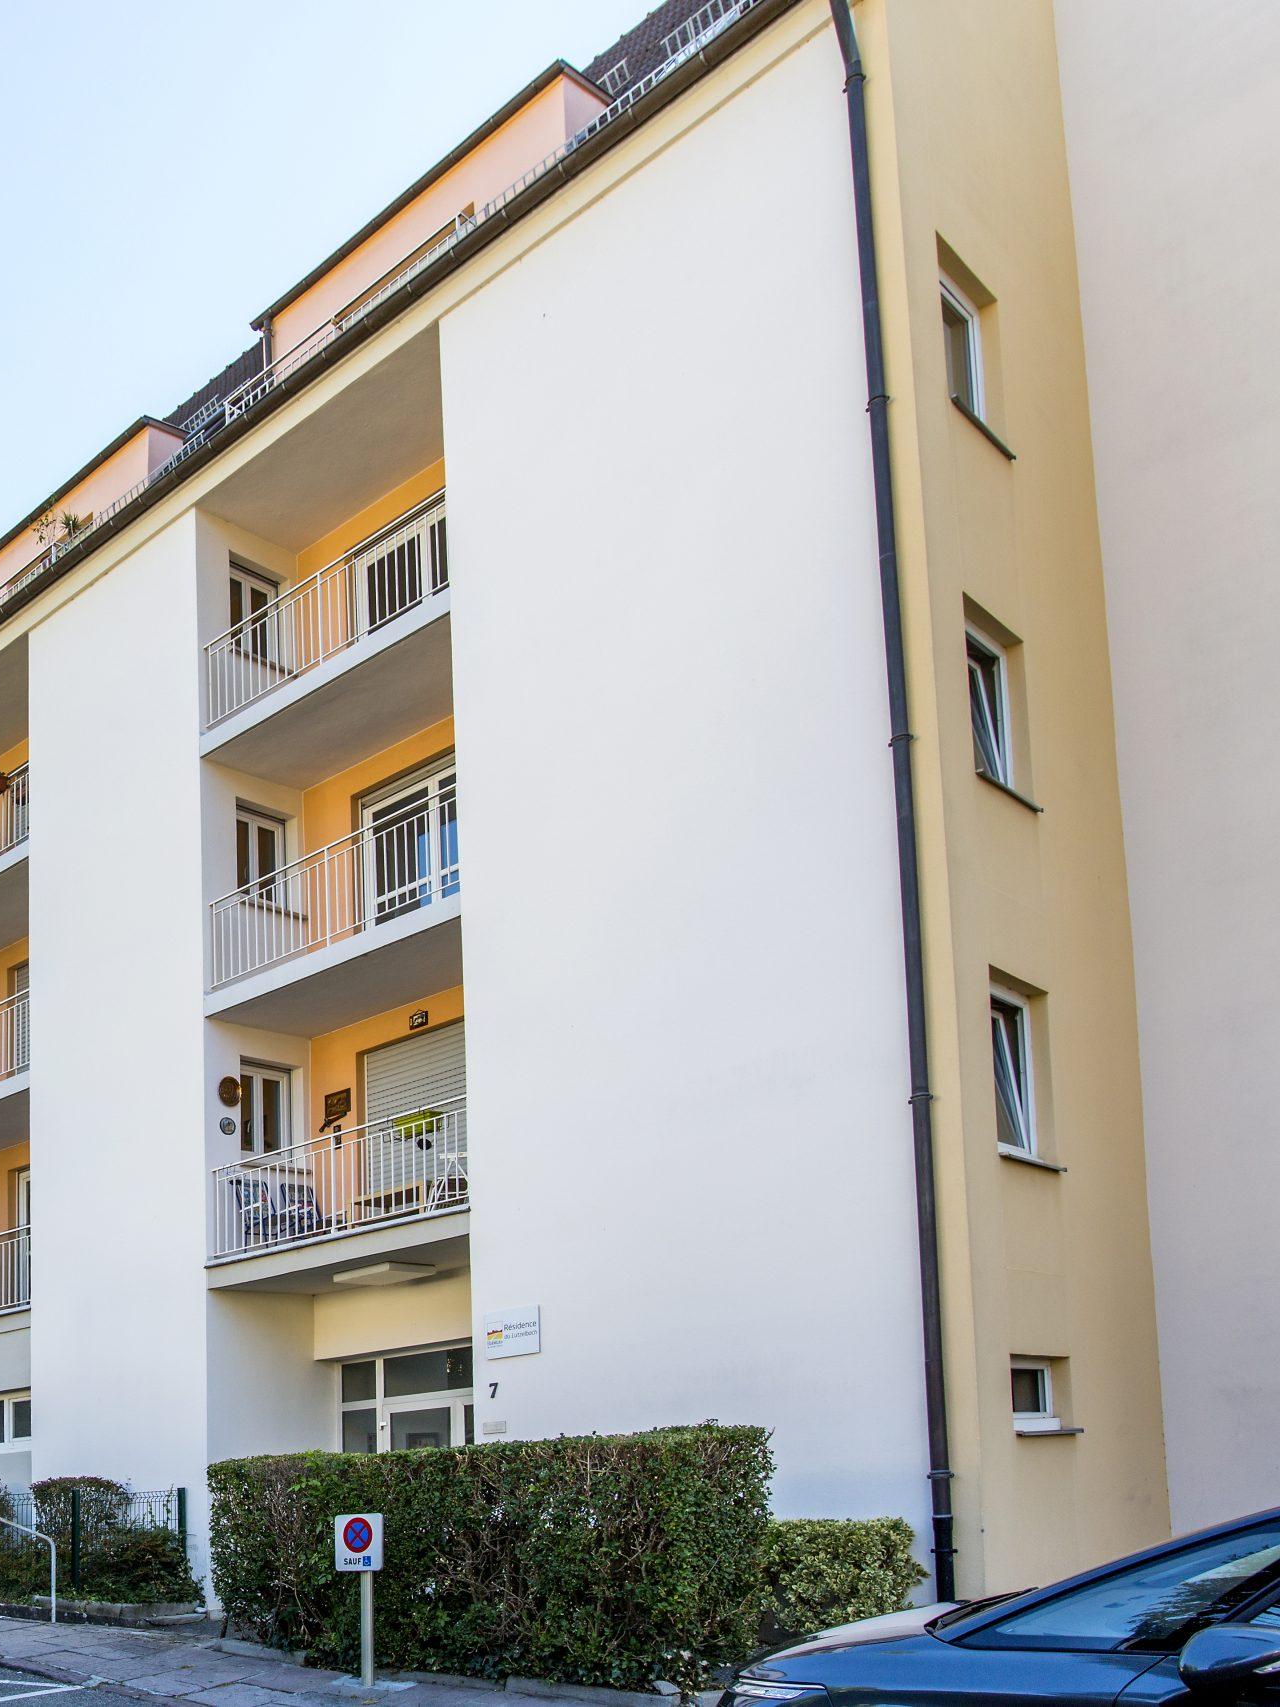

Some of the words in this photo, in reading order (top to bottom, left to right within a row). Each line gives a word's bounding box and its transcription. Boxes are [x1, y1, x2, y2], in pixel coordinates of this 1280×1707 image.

[503, 1320, 537, 1331] Résidence
[488, 1382, 499, 1399] 7
[343, 1557, 362, 1566] SAUF
